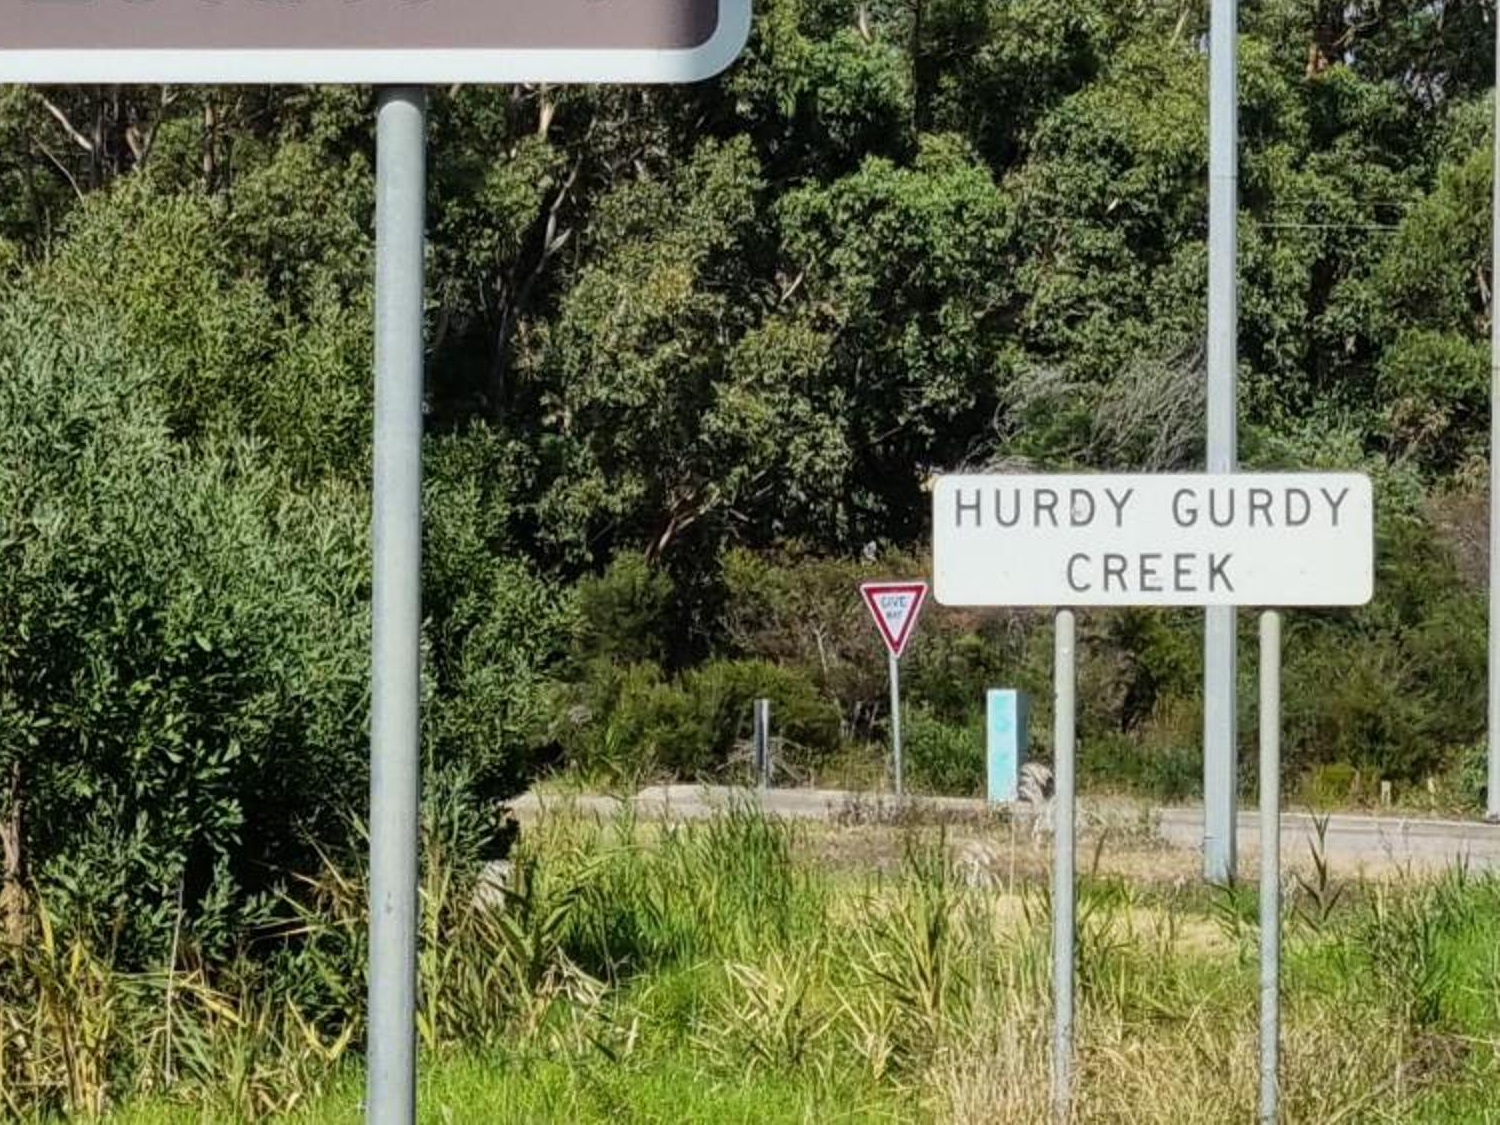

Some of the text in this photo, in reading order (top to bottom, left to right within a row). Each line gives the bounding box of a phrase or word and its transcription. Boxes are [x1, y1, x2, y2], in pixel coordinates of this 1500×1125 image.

[954, 487, 1351, 529] HURDY GURDY
[1065, 552, 1236, 593] CREEK
